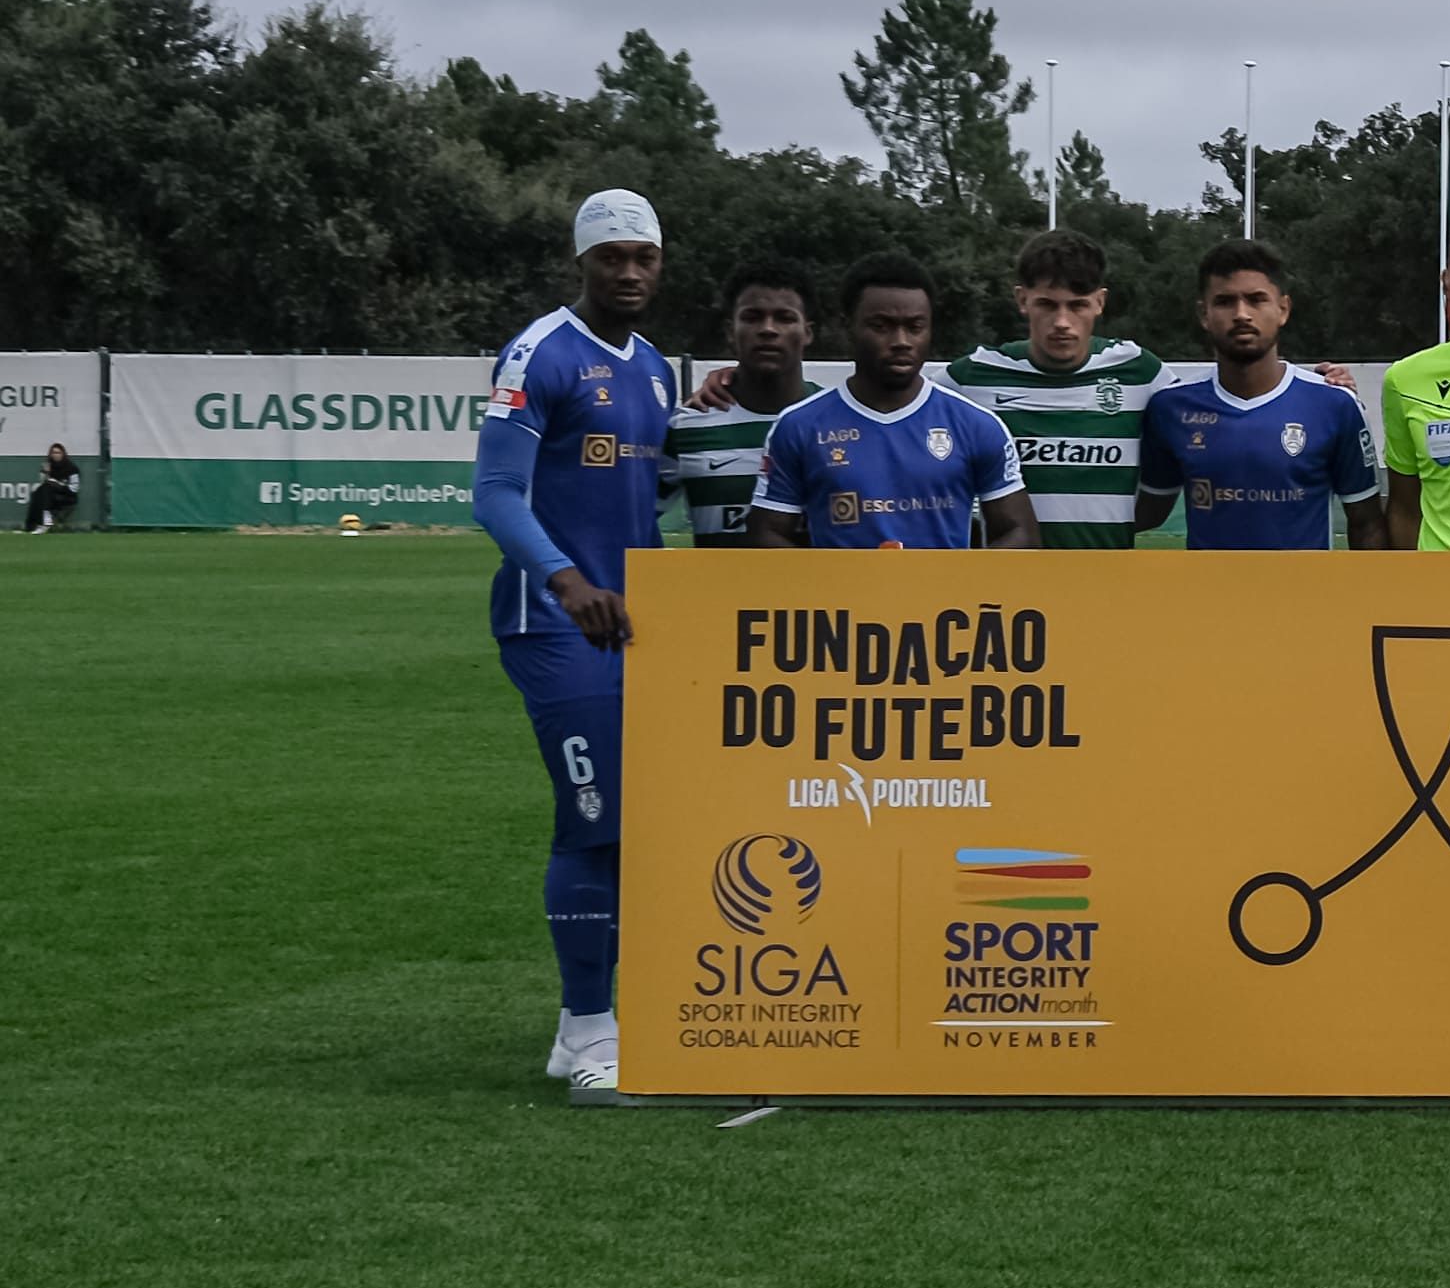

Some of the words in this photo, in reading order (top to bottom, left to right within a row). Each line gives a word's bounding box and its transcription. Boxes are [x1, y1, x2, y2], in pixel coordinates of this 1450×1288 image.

[195, 392, 489, 432] GLASSDRIVE
[1181, 412, 1219, 425] LAGO
[817, 428, 861, 445] LAGO
[1016, 438, 1122, 464] Betano
[862, 499, 895, 514] ESC
[1214, 488, 1245, 502] ESC
[736, 603, 1046, 686] FUNDAÇÃO
[722, 684, 796, 748] DO
[813, 684, 1081, 761] FUTEBOL
[563, 735, 595, 785] 6
[788, 778, 839, 808] LIGA
[872, 778, 992, 808] PORTUGAL
[943, 921, 1099, 962] SPORT
[694, 943, 849, 997] SIGA
[945, 966, 1090, 989] INTEGRITY
[679, 1003, 744, 1023] SPORT
[752, 1003, 863, 1023] INTEGRITY
[679, 1029, 761, 1049] GLOBAL
[763, 1029, 861, 1048] ALLIANCE
[943, 1031, 1098, 1048] NOVEMBER
